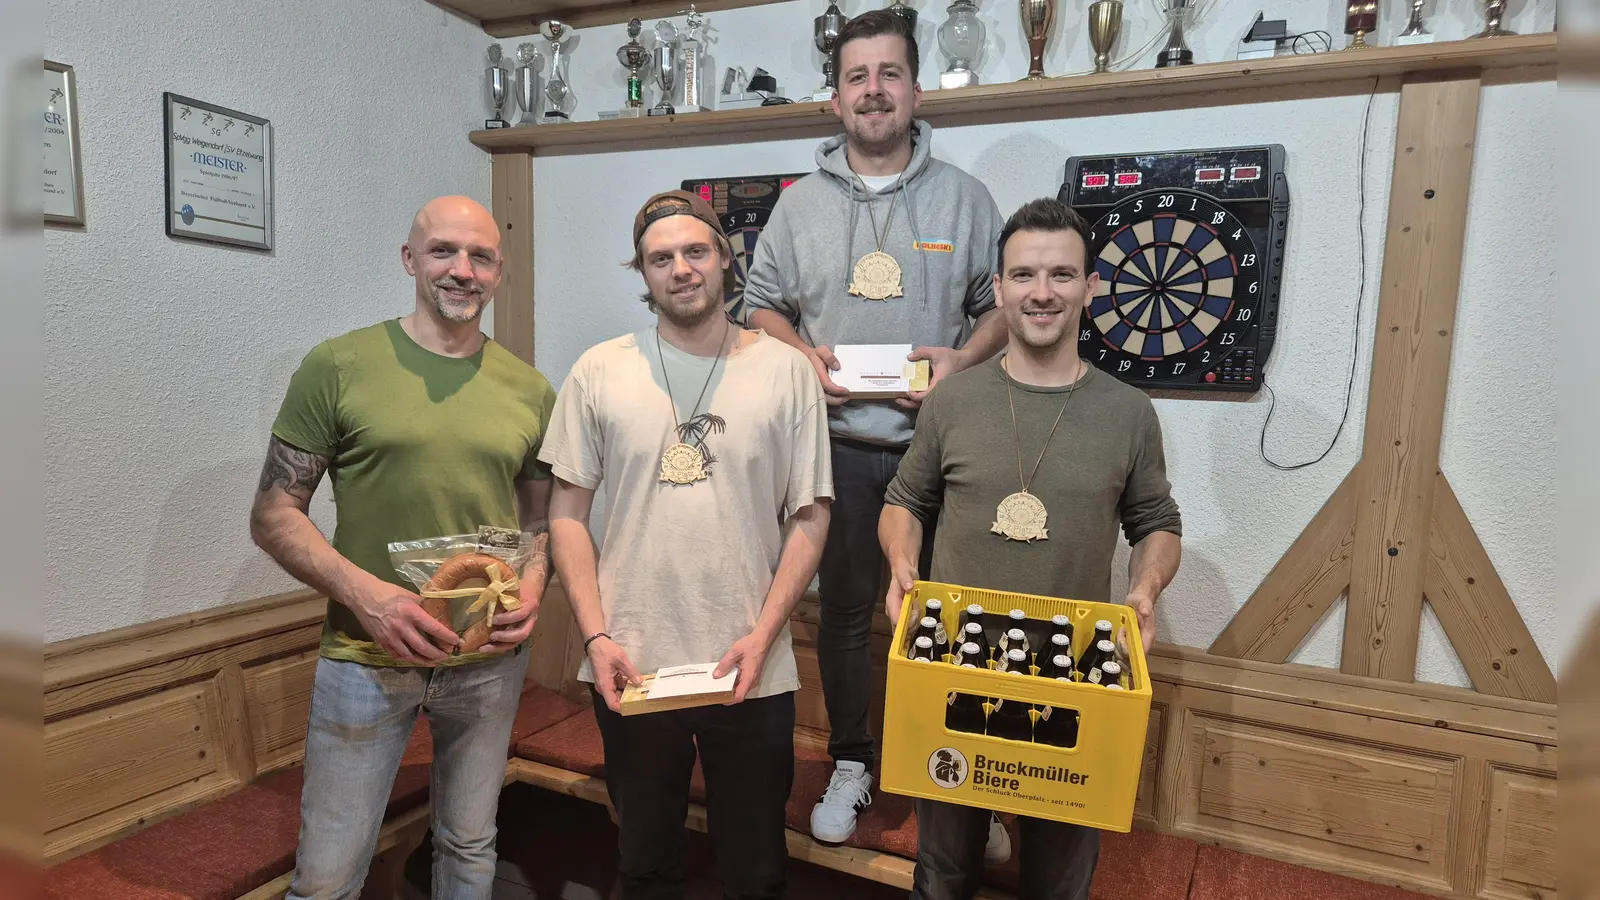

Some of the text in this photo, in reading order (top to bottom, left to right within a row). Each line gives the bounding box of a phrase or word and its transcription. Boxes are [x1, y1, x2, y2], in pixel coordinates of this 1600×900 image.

[172, 132, 191, 145] SpVgg
[211, 127, 221, 137] SG
[1134, 199, 1143, 212] 5
[1157, 195, 1174, 207] 20
[1189, 198, 1198, 211] 1
[729, 216, 736, 227] 5
[745, 212, 757, 223] 20
[1107, 213, 1120, 226] 12
[1211, 211, 1226, 225] 18
[1232, 228, 1242, 241] 4
[1240, 254, 1256, 267] 13
[1248, 281, 1258, 294] 6
[1236, 308, 1251, 321] 10
[1079, 329, 1091, 341] 16
[1220, 332, 1235, 345] 15
[1098, 349, 1107, 361] 7
[1202, 351, 1211, 363] 2
[1117, 360, 1132, 372] 19
[1146, 366, 1155, 378] 3
[1172, 362, 1187, 375] 17
[974, 754, 1089, 786] Bruckmüller
[973, 770, 1020, 790] Biere
[986, 787, 1012, 797] Schluck
[1013, 792, 1045, 802] Oberpfalz
